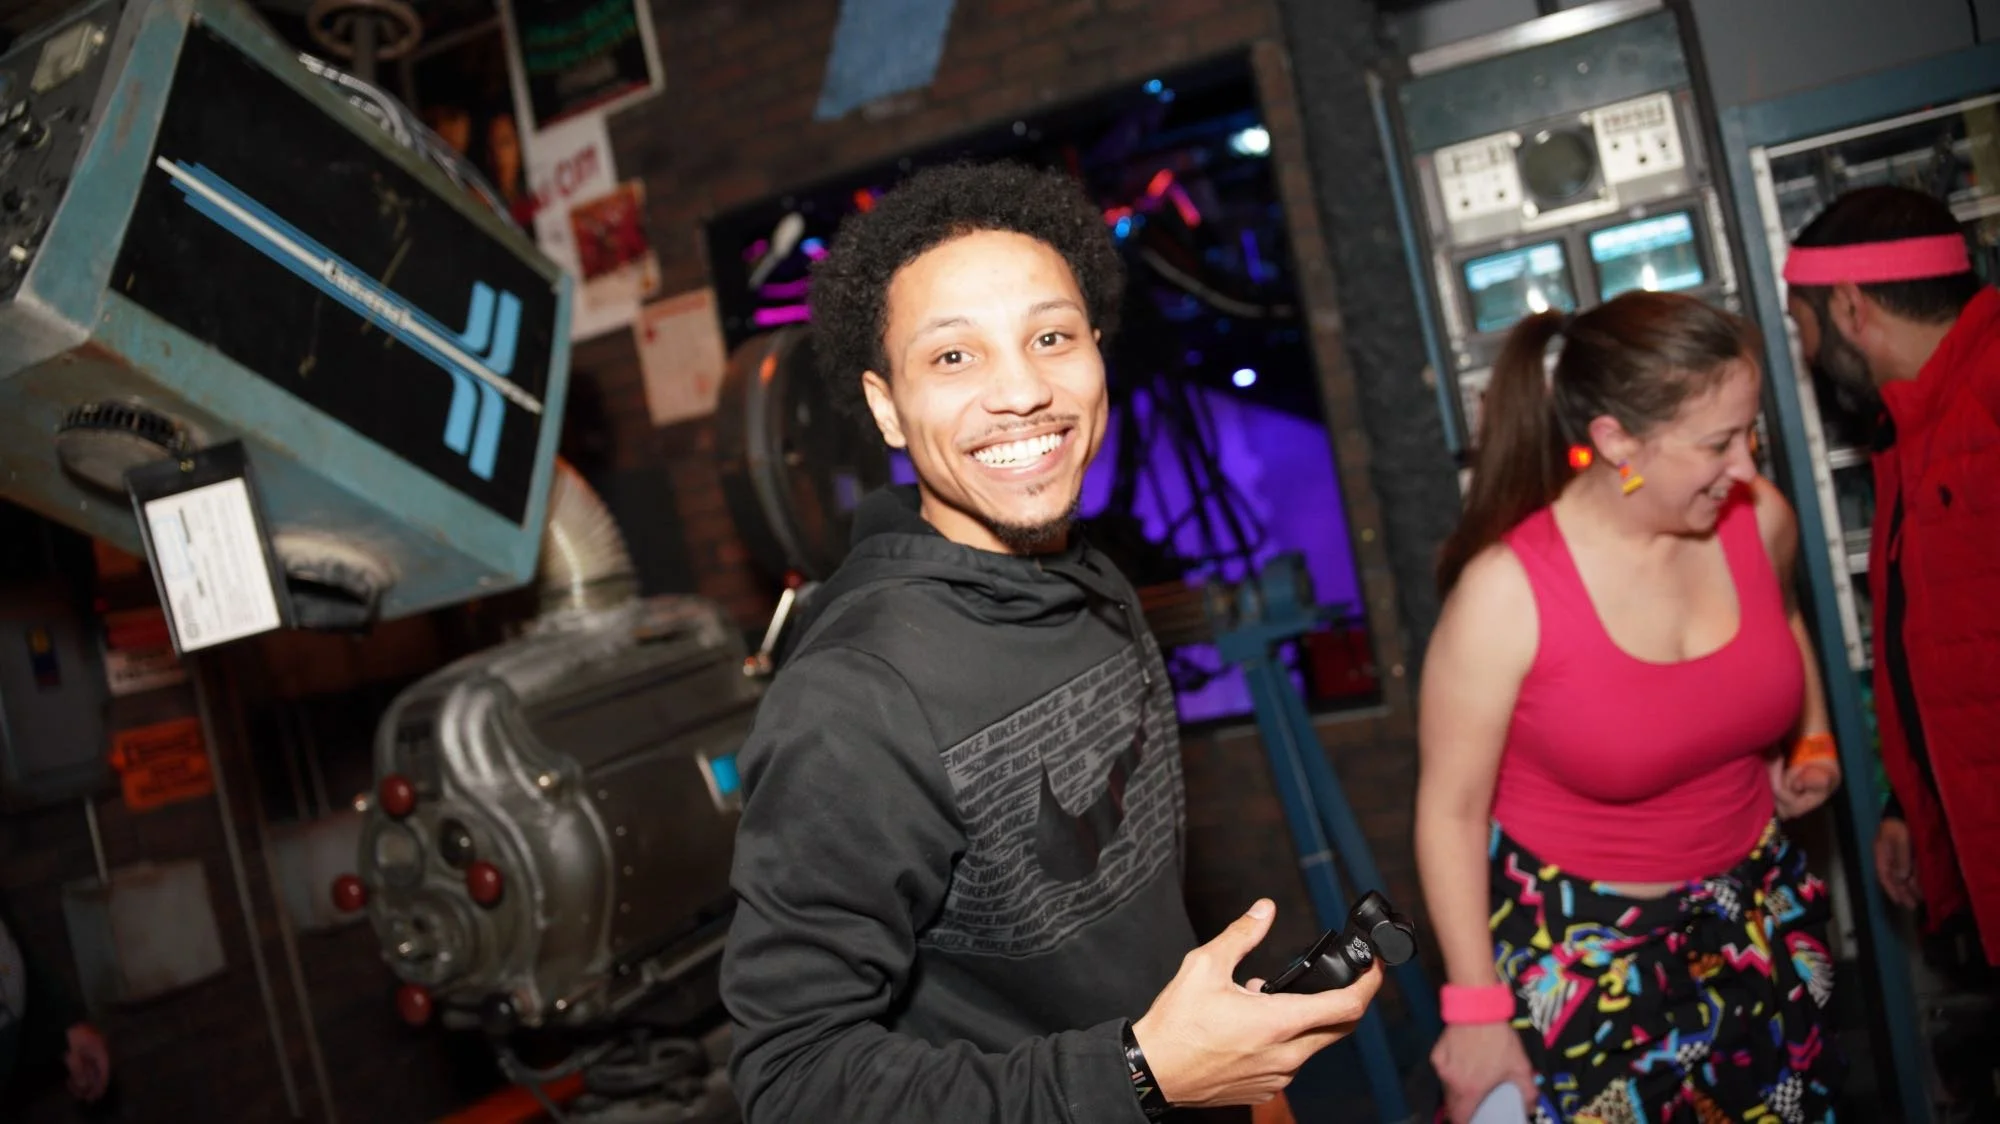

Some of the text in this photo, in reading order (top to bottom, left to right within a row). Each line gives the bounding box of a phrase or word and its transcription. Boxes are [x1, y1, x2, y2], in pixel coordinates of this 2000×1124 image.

[950, 734, 984, 766] NIKE
[986, 716, 1018, 746] NIKE
[1012, 745, 1038, 772] NIKE
[978, 863, 1008, 882] NIKE
